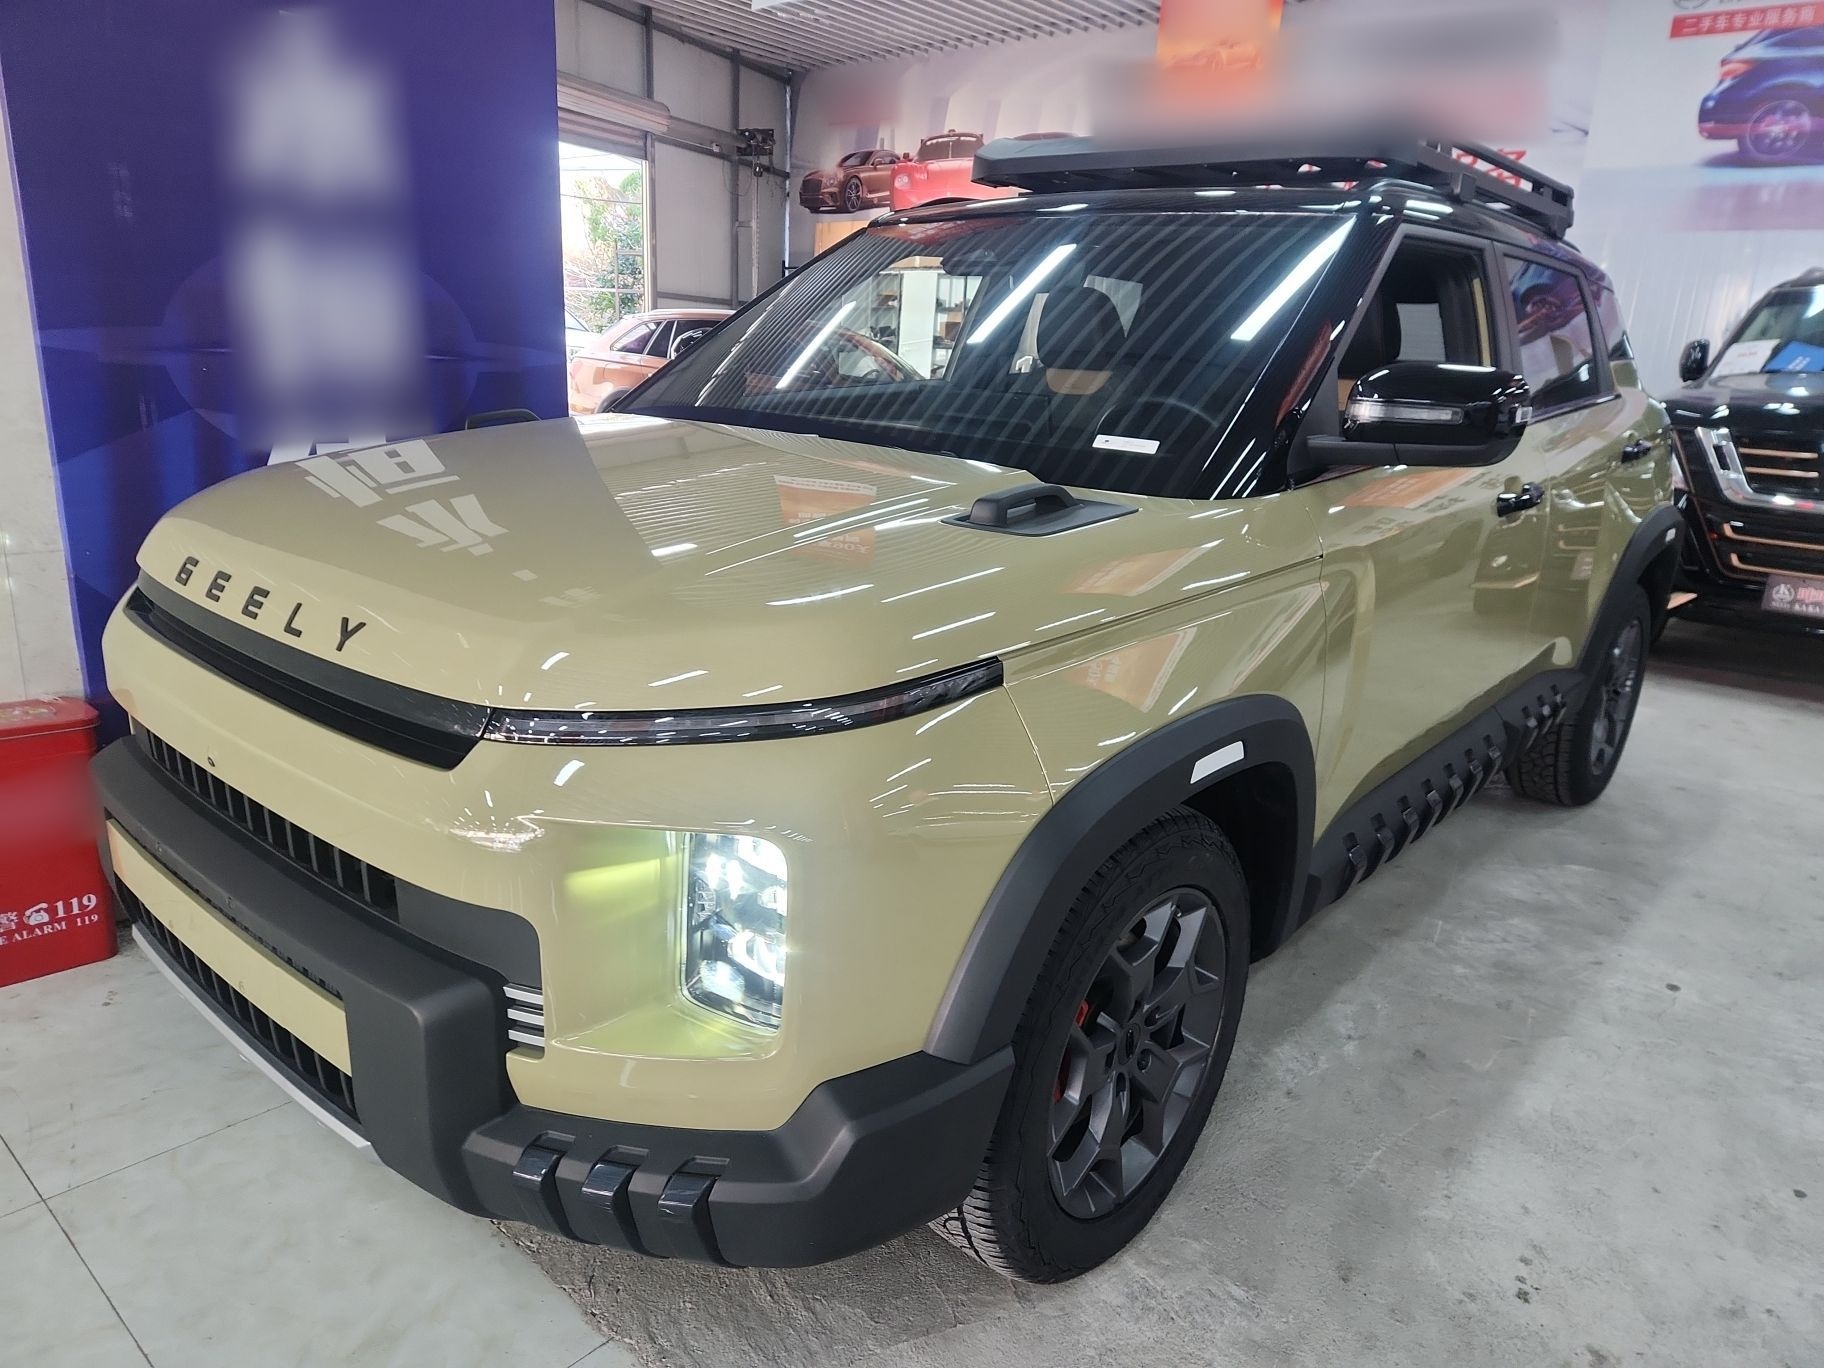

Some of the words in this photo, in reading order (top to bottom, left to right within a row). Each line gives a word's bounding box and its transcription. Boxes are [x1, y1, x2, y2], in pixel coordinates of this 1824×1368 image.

[175, 556, 367, 652] GEELY
[53, 893, 97, 918] 119
[13, 921, 67, 942] ALARM
[76, 914, 99, 926] 119
